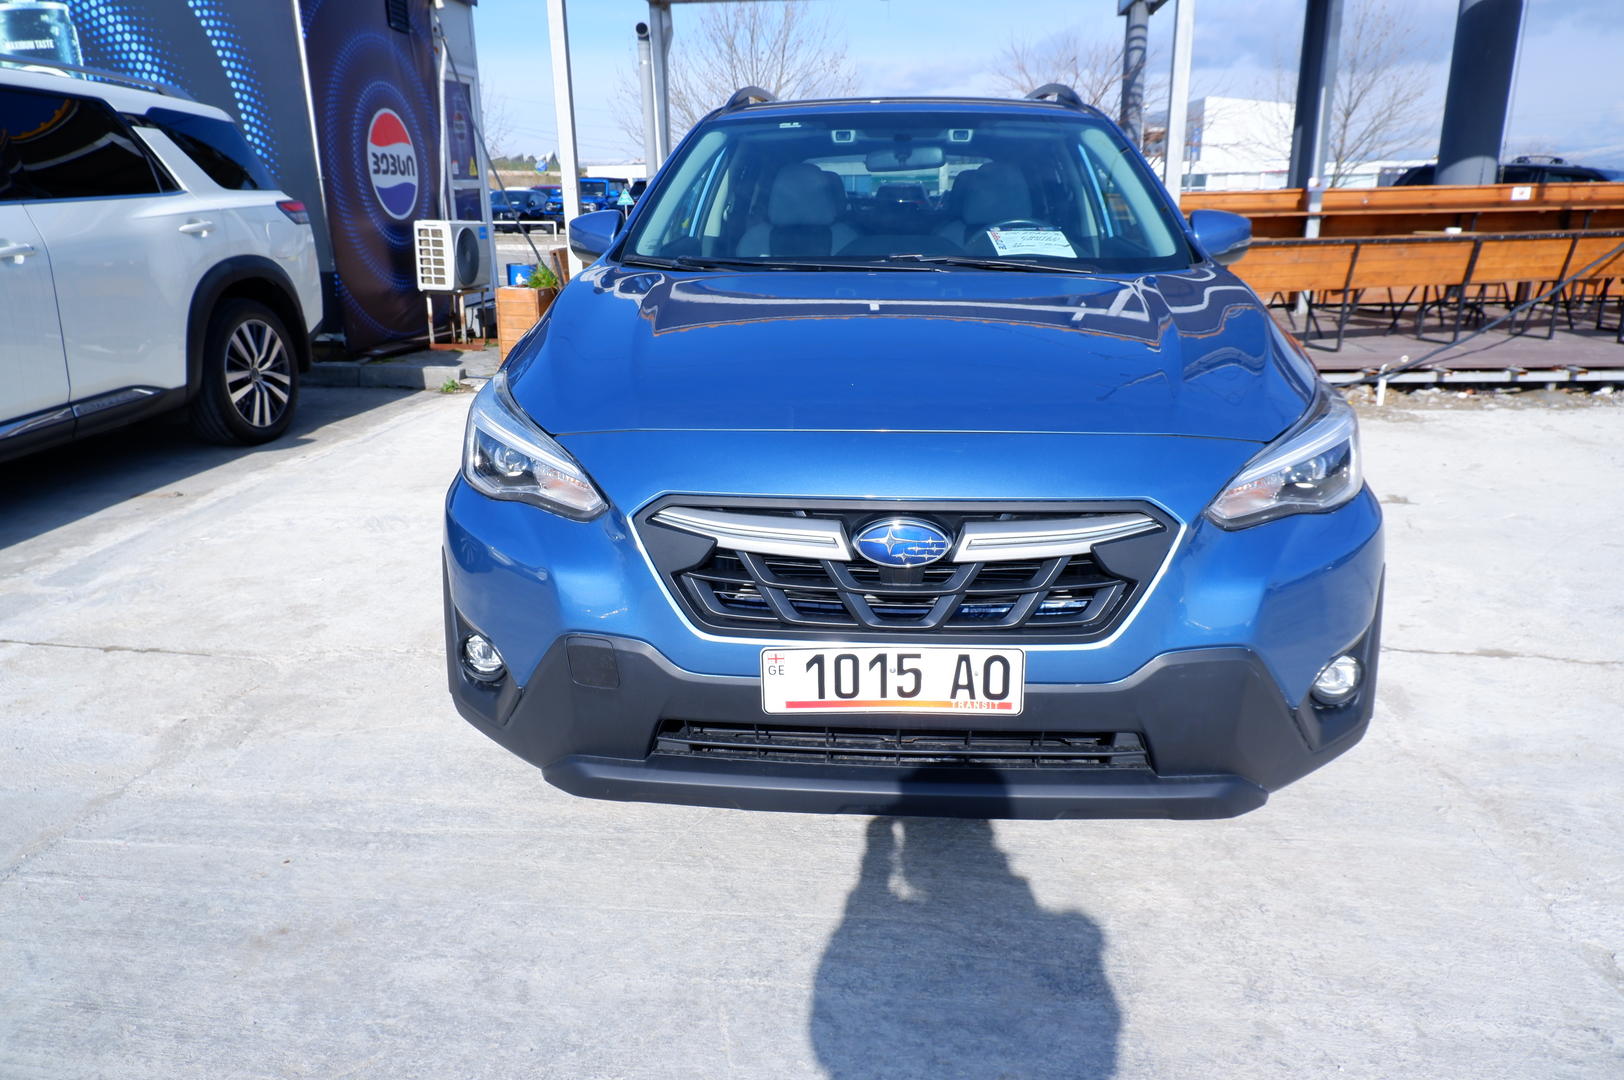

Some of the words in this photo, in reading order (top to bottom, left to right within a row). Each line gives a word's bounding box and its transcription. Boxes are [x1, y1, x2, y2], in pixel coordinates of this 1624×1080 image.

[767, 664, 785, 676] GE
[805, 653, 922, 700] 1015
[951, 701, 1000, 710] TRANSIT
